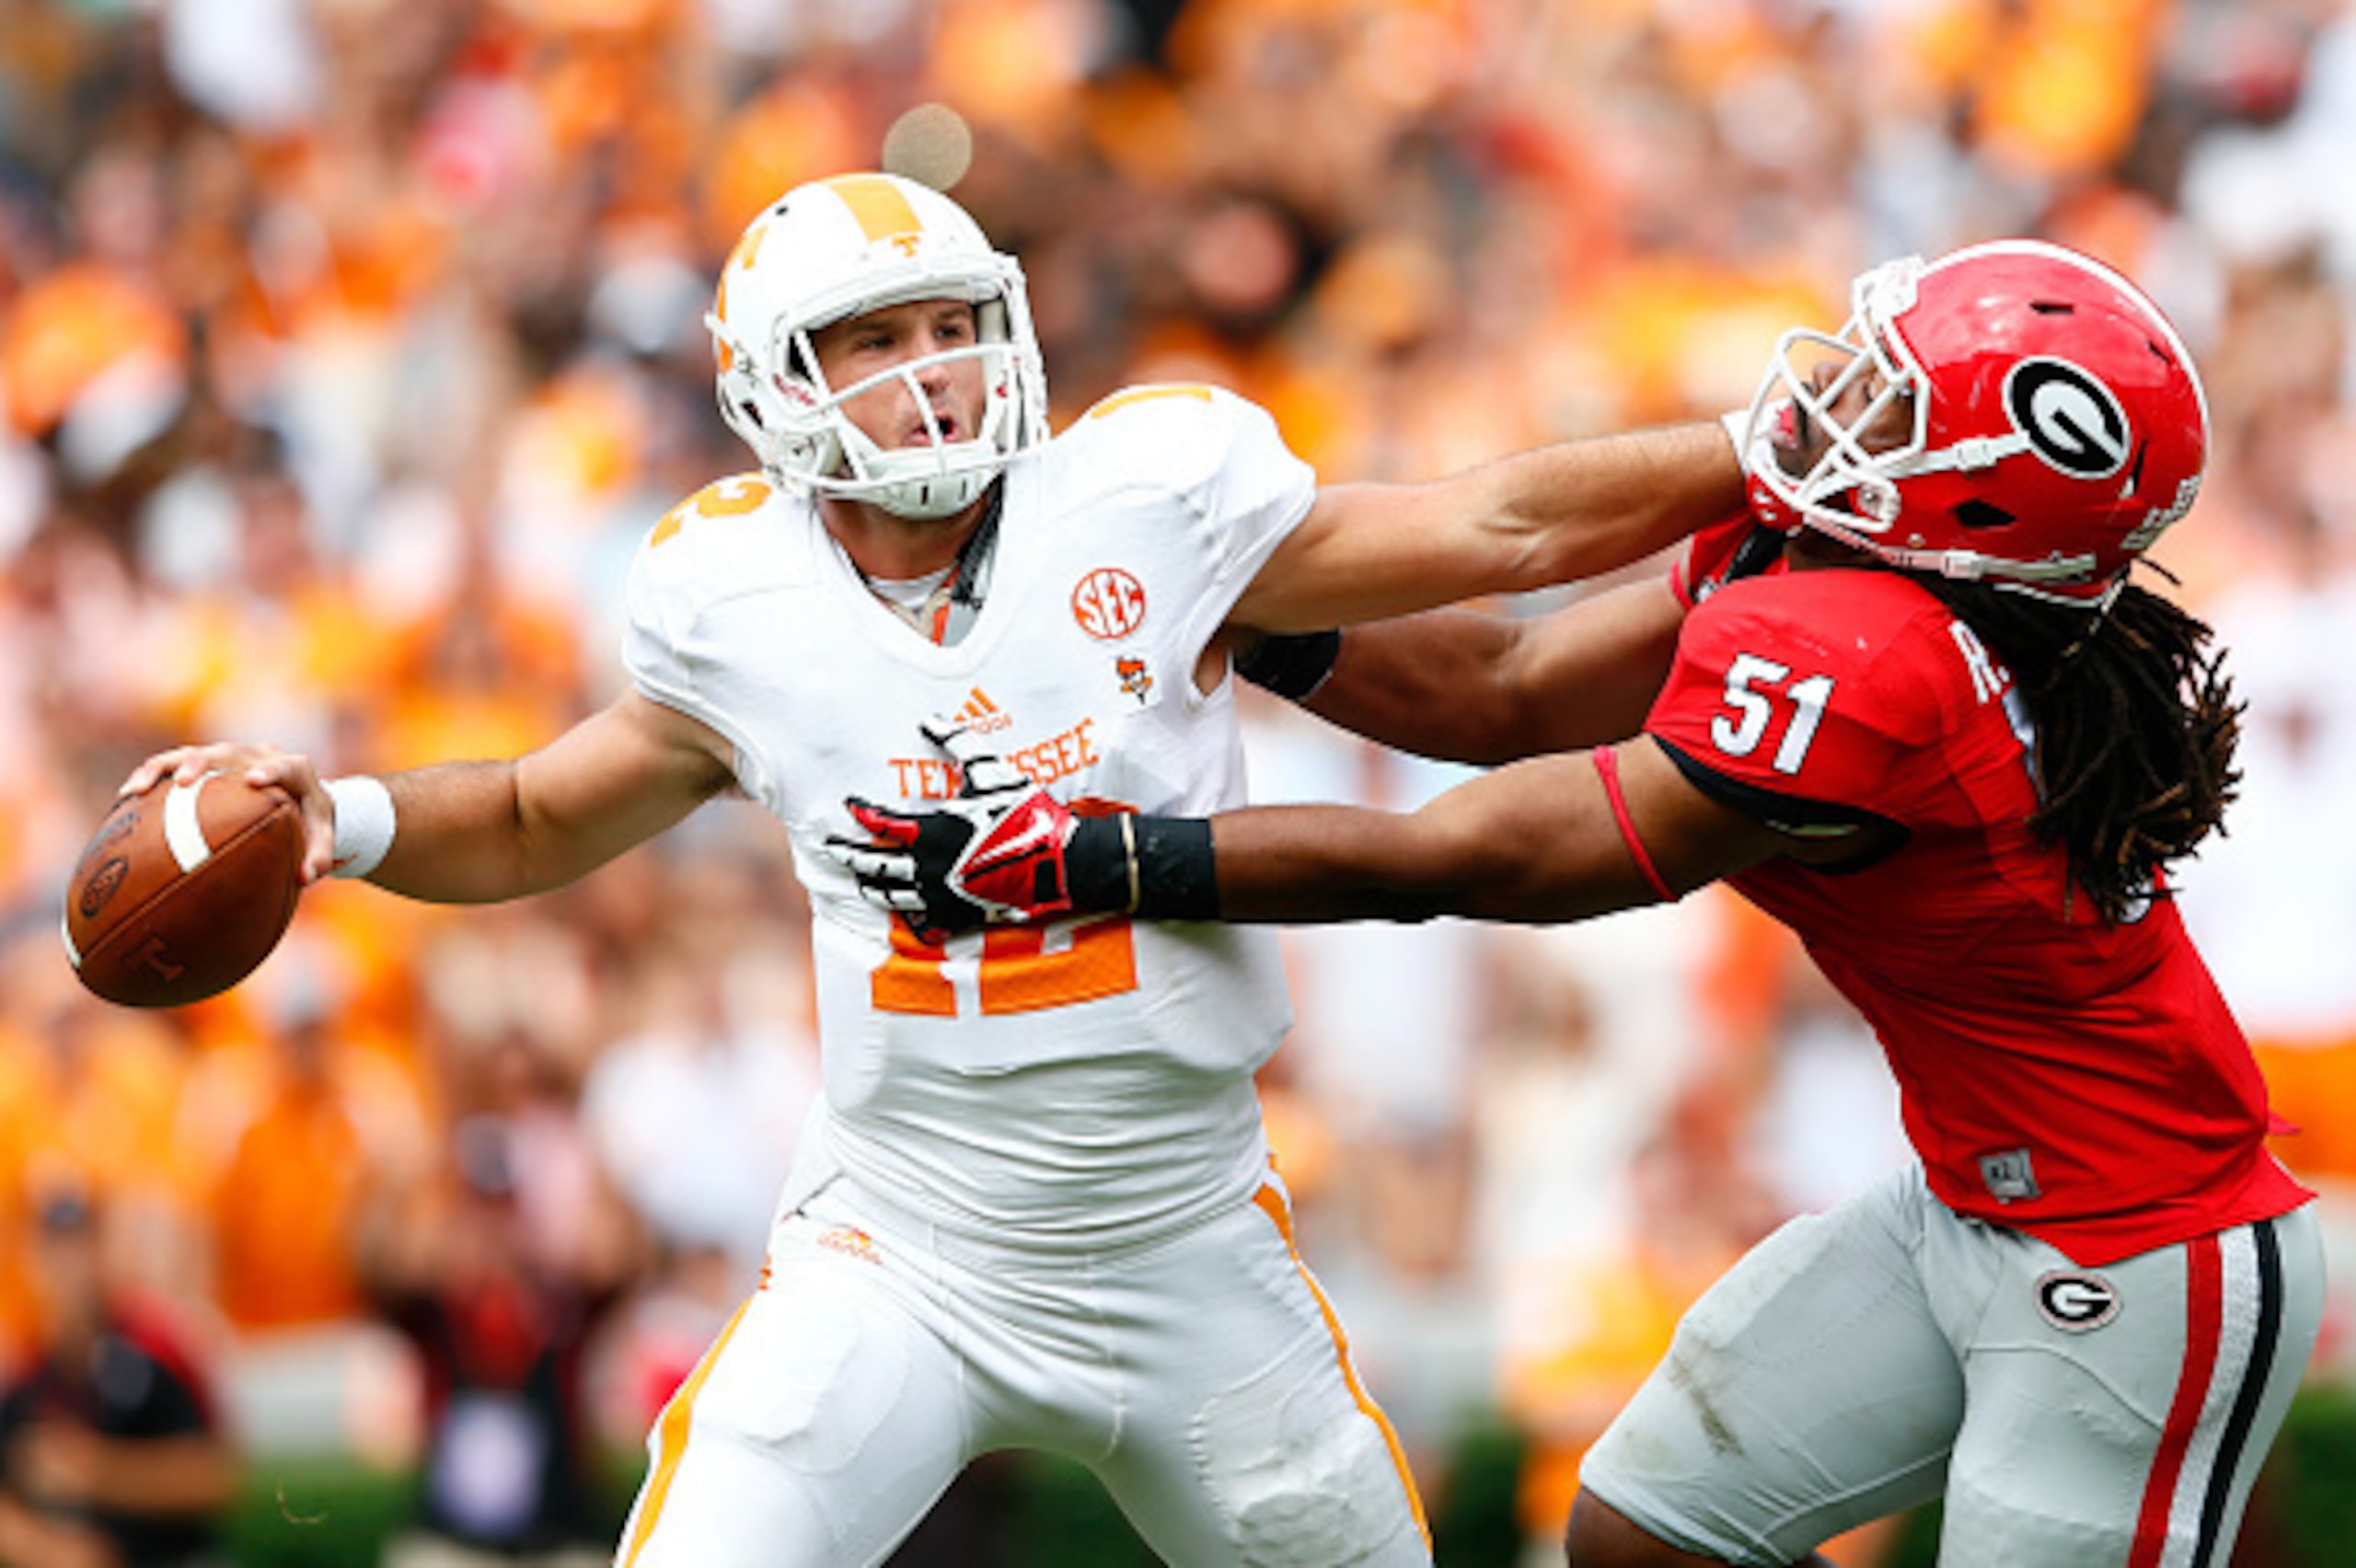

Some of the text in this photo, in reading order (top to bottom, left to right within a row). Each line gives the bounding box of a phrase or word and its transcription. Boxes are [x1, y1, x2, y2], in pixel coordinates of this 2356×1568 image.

[2027, 375, 2126, 466] G
[1070, 567, 1146, 639] SEC
[1710, 652, 1838, 775] 51
[887, 717, 1101, 800] TENSSEE
